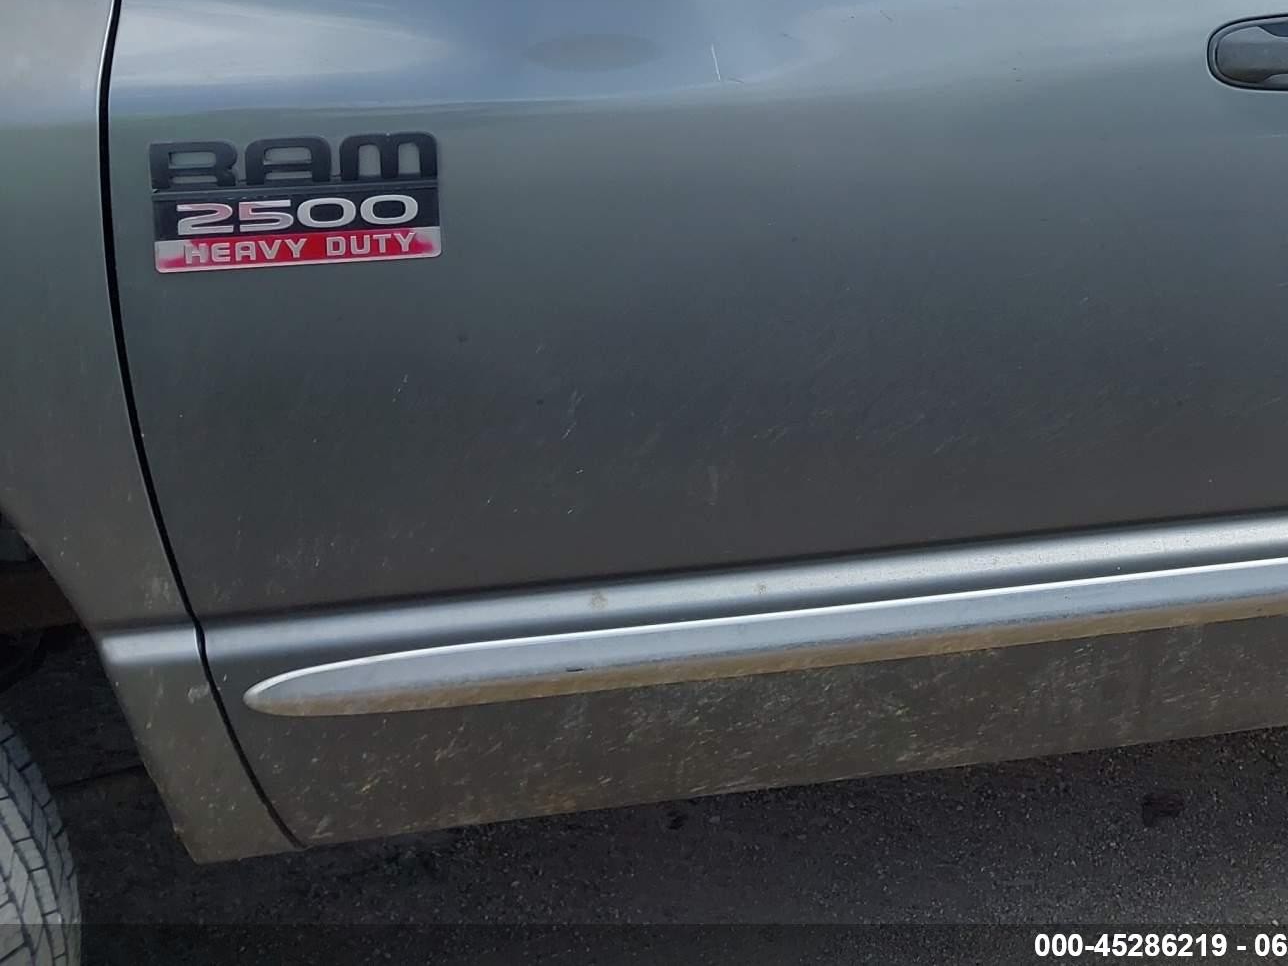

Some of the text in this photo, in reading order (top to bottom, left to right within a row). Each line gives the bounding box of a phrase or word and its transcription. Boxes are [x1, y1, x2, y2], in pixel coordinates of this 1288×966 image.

[149, 131, 439, 190] RAM
[176, 194, 419, 235] 2500
[184, 231, 417, 264] HEAVY DUTY
